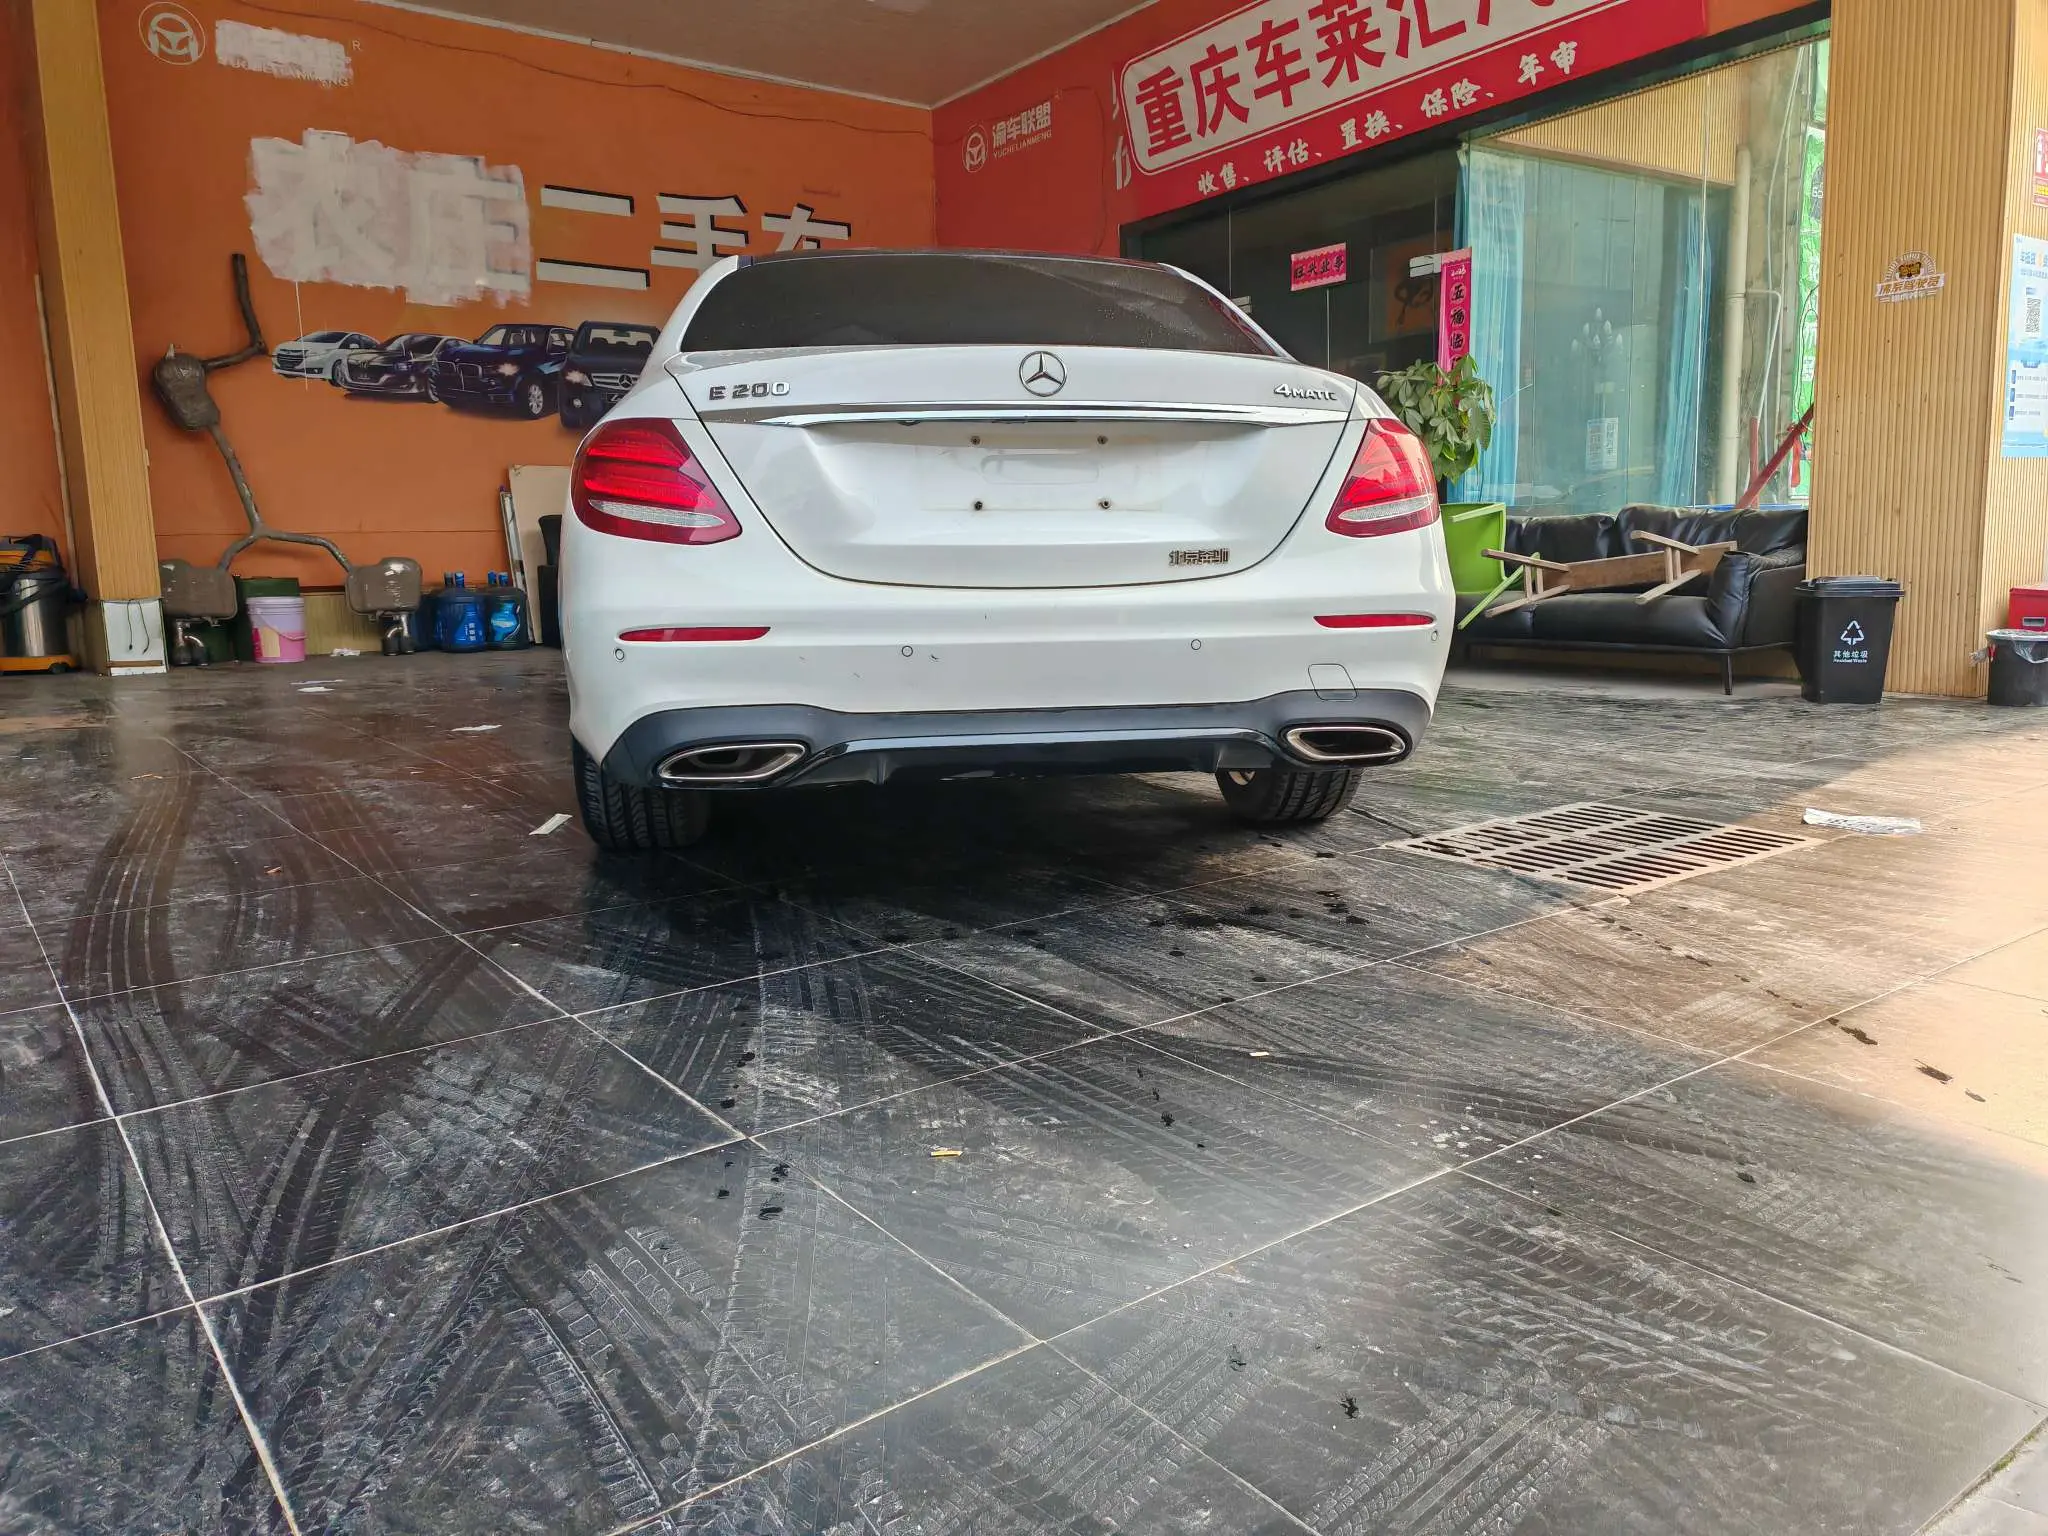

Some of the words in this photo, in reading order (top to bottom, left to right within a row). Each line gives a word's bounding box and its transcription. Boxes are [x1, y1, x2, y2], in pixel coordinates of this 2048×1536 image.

[992, 101, 1052, 149] 渝车联盟
[708, 385, 727, 401] E
[732, 381, 790, 399] 200
[1274, 383, 1338, 401] 4MATIC
[1169, 548, 1229, 566] 北京奔驰
[1833, 650, 1868, 659] 其他垃圾
